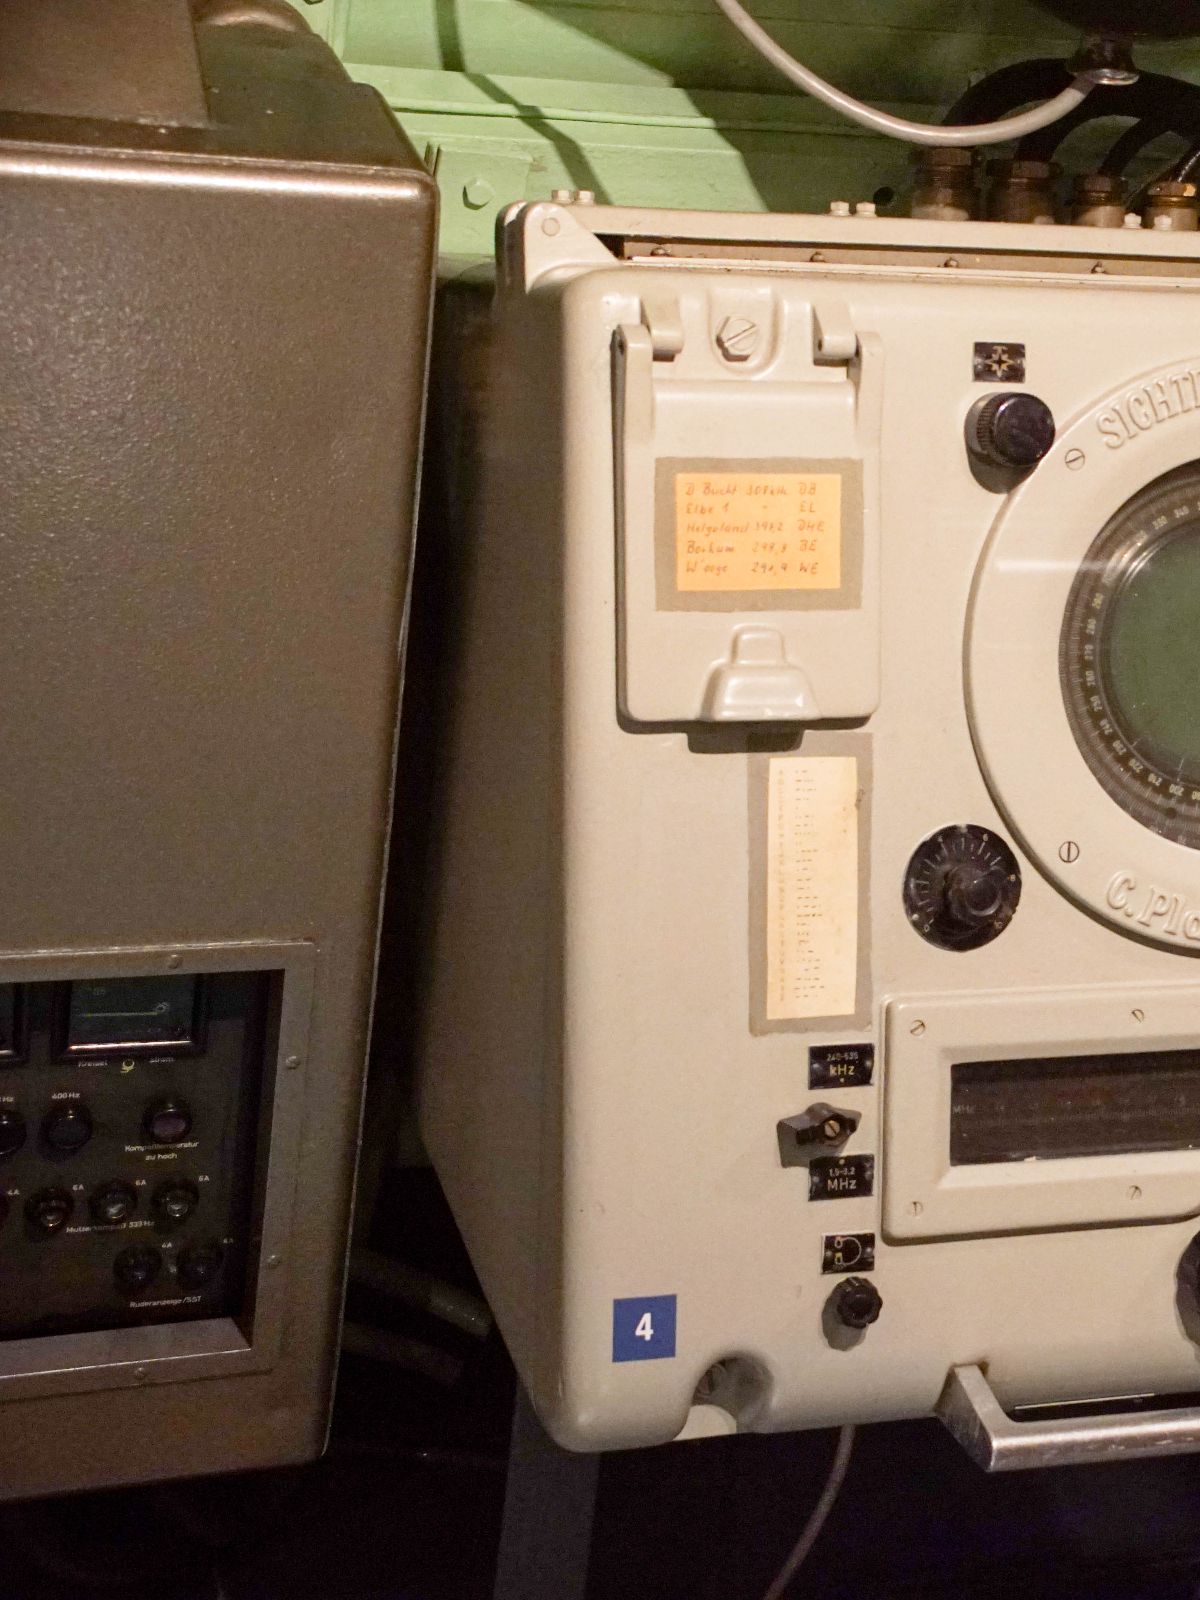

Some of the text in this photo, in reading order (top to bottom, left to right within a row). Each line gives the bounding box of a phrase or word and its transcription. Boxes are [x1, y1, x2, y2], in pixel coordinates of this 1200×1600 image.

[1106, 870, 1135, 917] C.
[829, 1064, 856, 1077] kHz
[827, 1177, 857, 1191] MHz
[634, 1312, 654, 1342] 4
